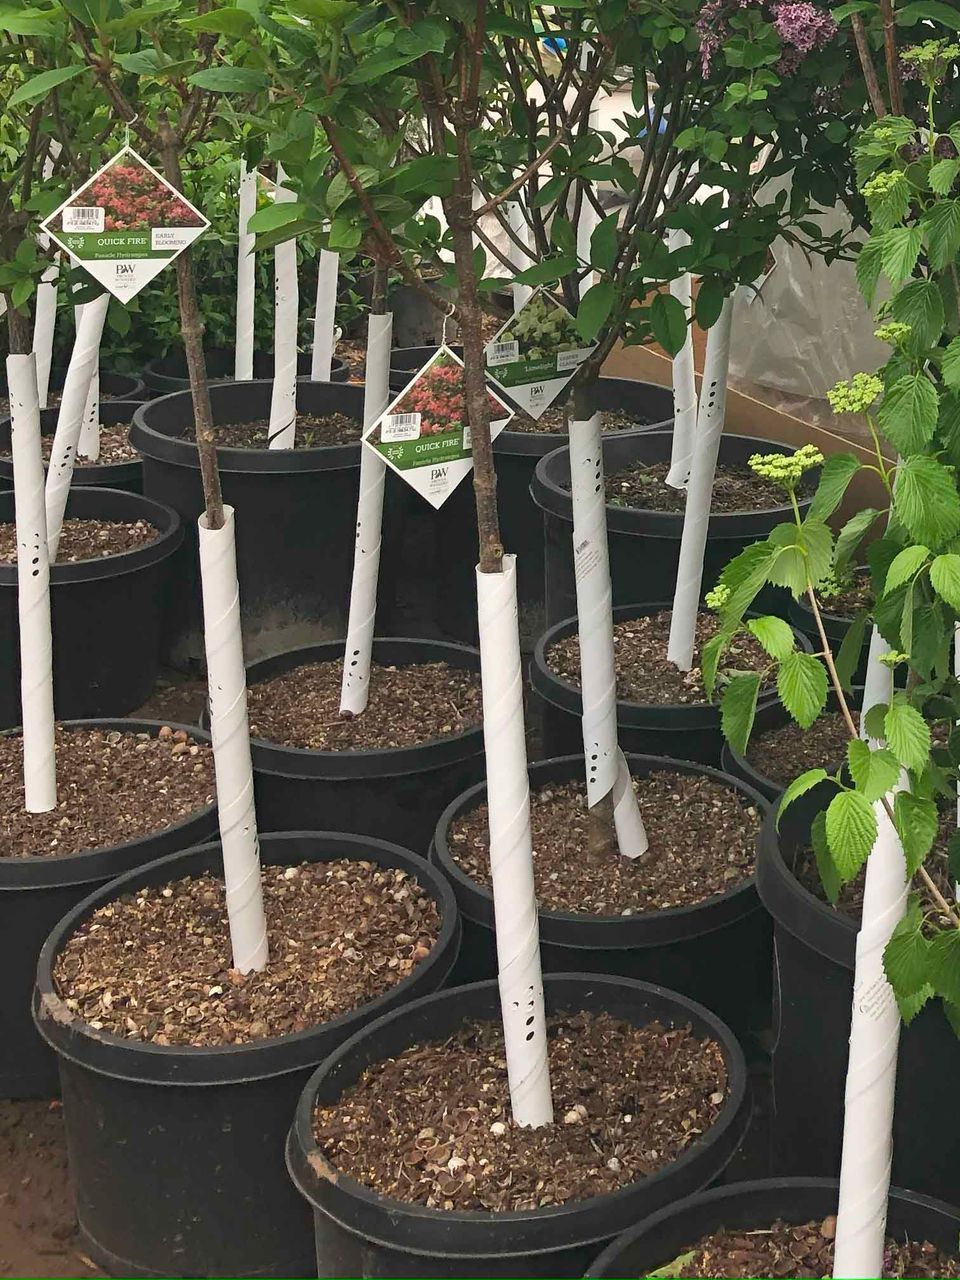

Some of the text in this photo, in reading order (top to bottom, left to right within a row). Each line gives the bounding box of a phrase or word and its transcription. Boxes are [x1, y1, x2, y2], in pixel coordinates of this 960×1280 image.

[97, 237, 147, 247] QUICK FIRE
[415, 441, 440, 453] QUICK
[441, 438, 460, 449] FIRE
